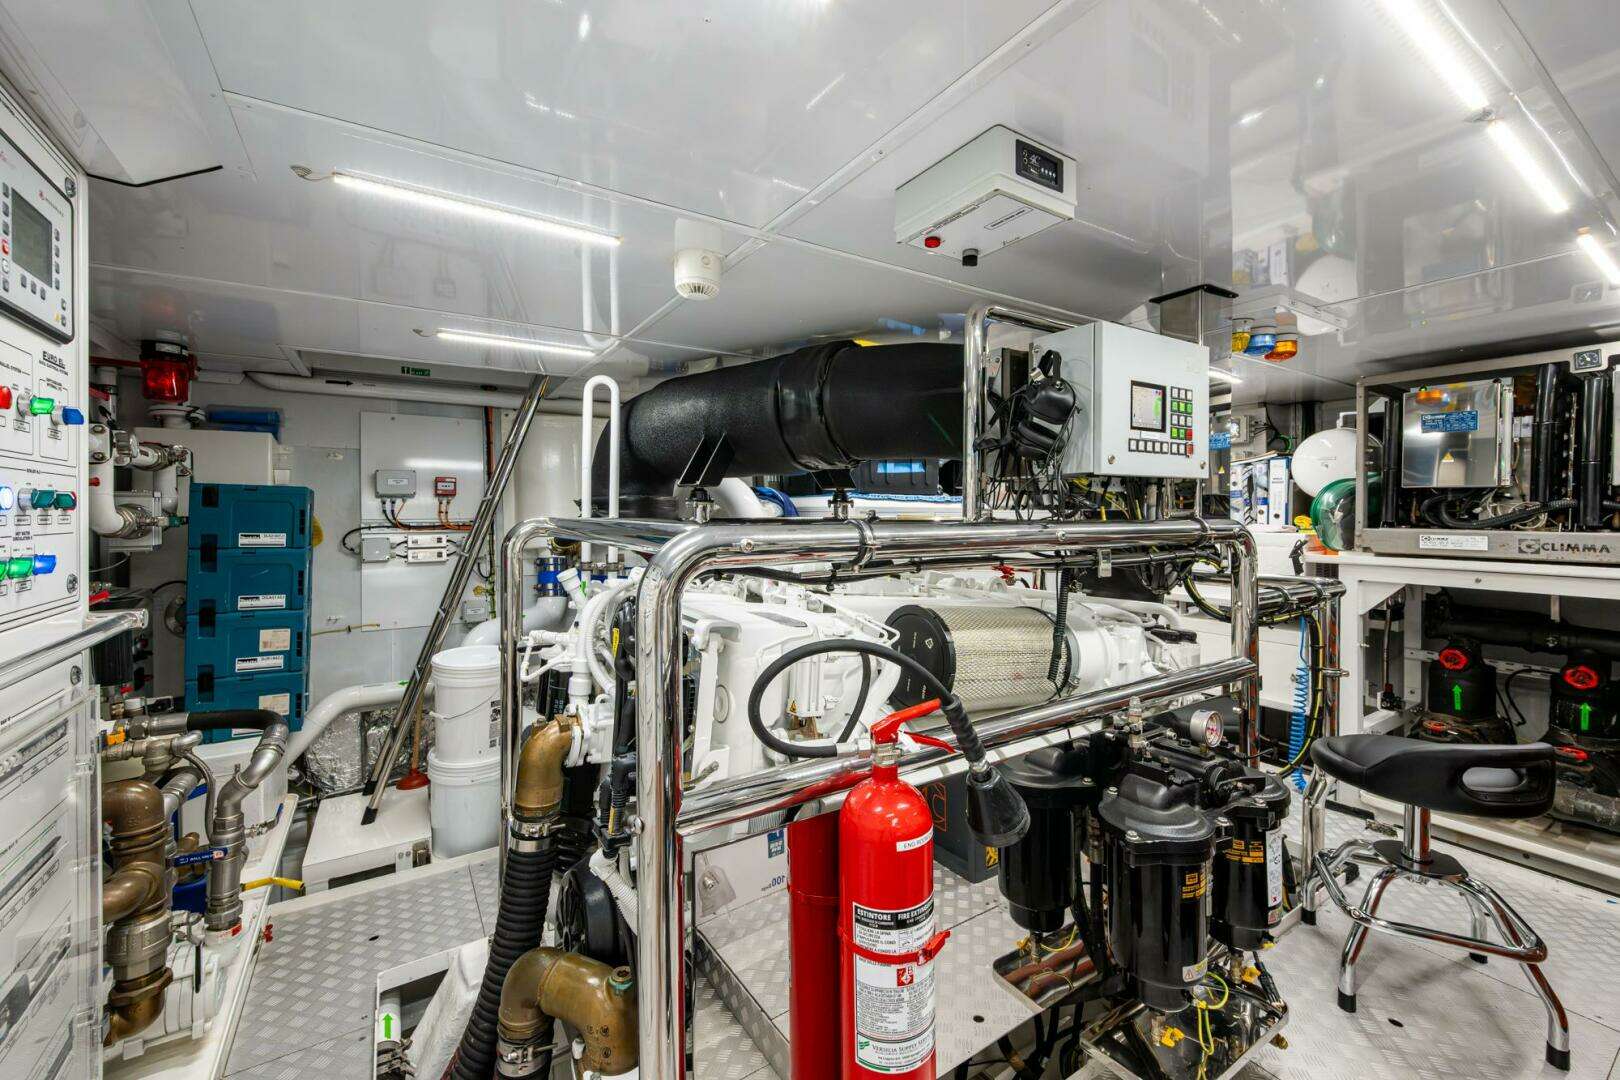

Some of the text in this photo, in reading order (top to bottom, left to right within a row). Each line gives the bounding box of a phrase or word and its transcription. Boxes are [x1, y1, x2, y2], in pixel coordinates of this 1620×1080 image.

[1541, 543, 1610, 553] CLIMMA
[857, 908, 891, 920] ESTINTORE
[898, 1043, 917, 1051] SUPPLY
